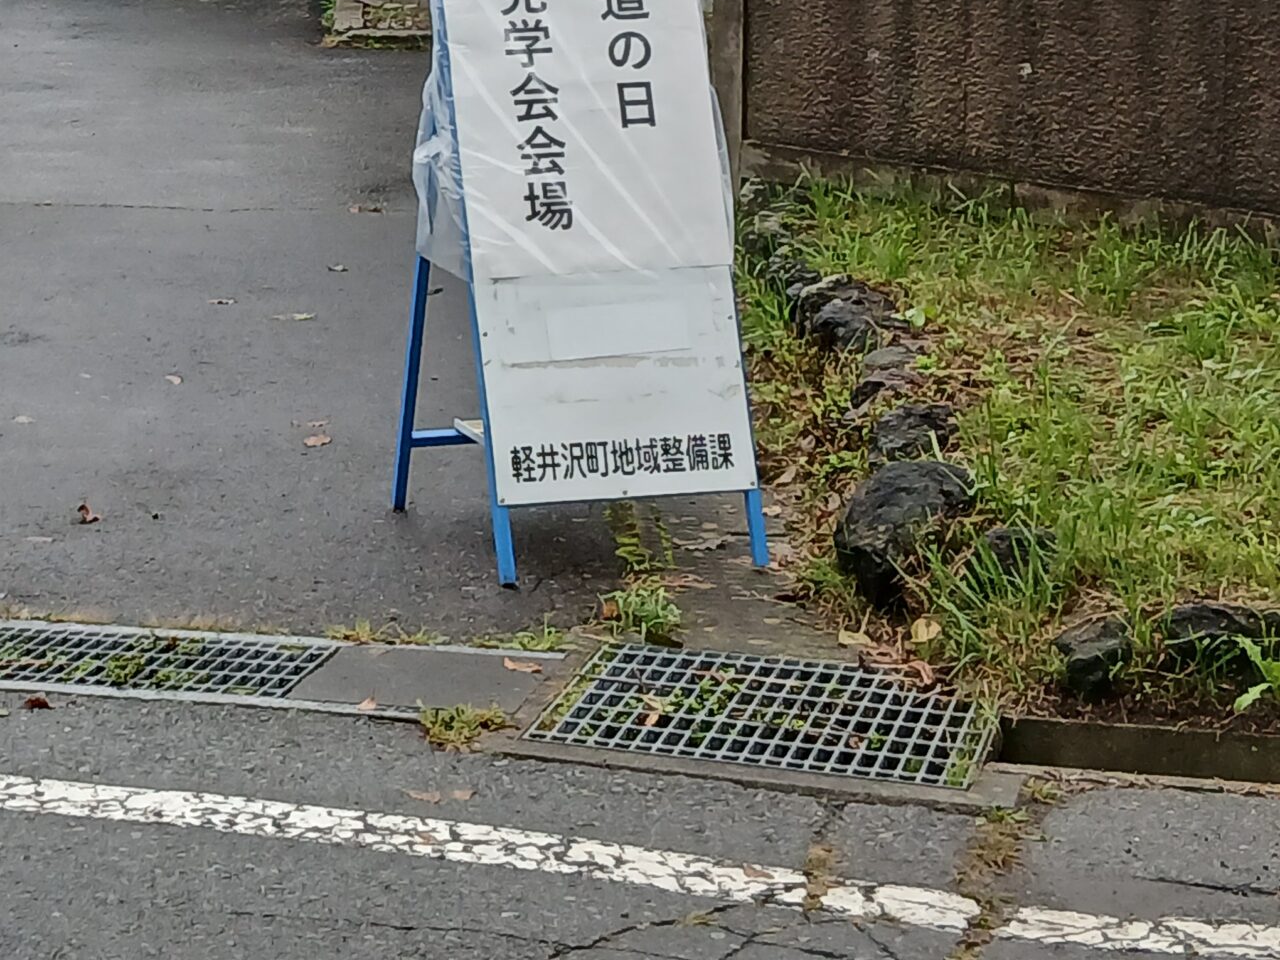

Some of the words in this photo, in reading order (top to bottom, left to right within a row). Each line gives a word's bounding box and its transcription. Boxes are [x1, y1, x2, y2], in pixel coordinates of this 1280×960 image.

[510, 433, 735, 483] 軽井沢町地域整備課
